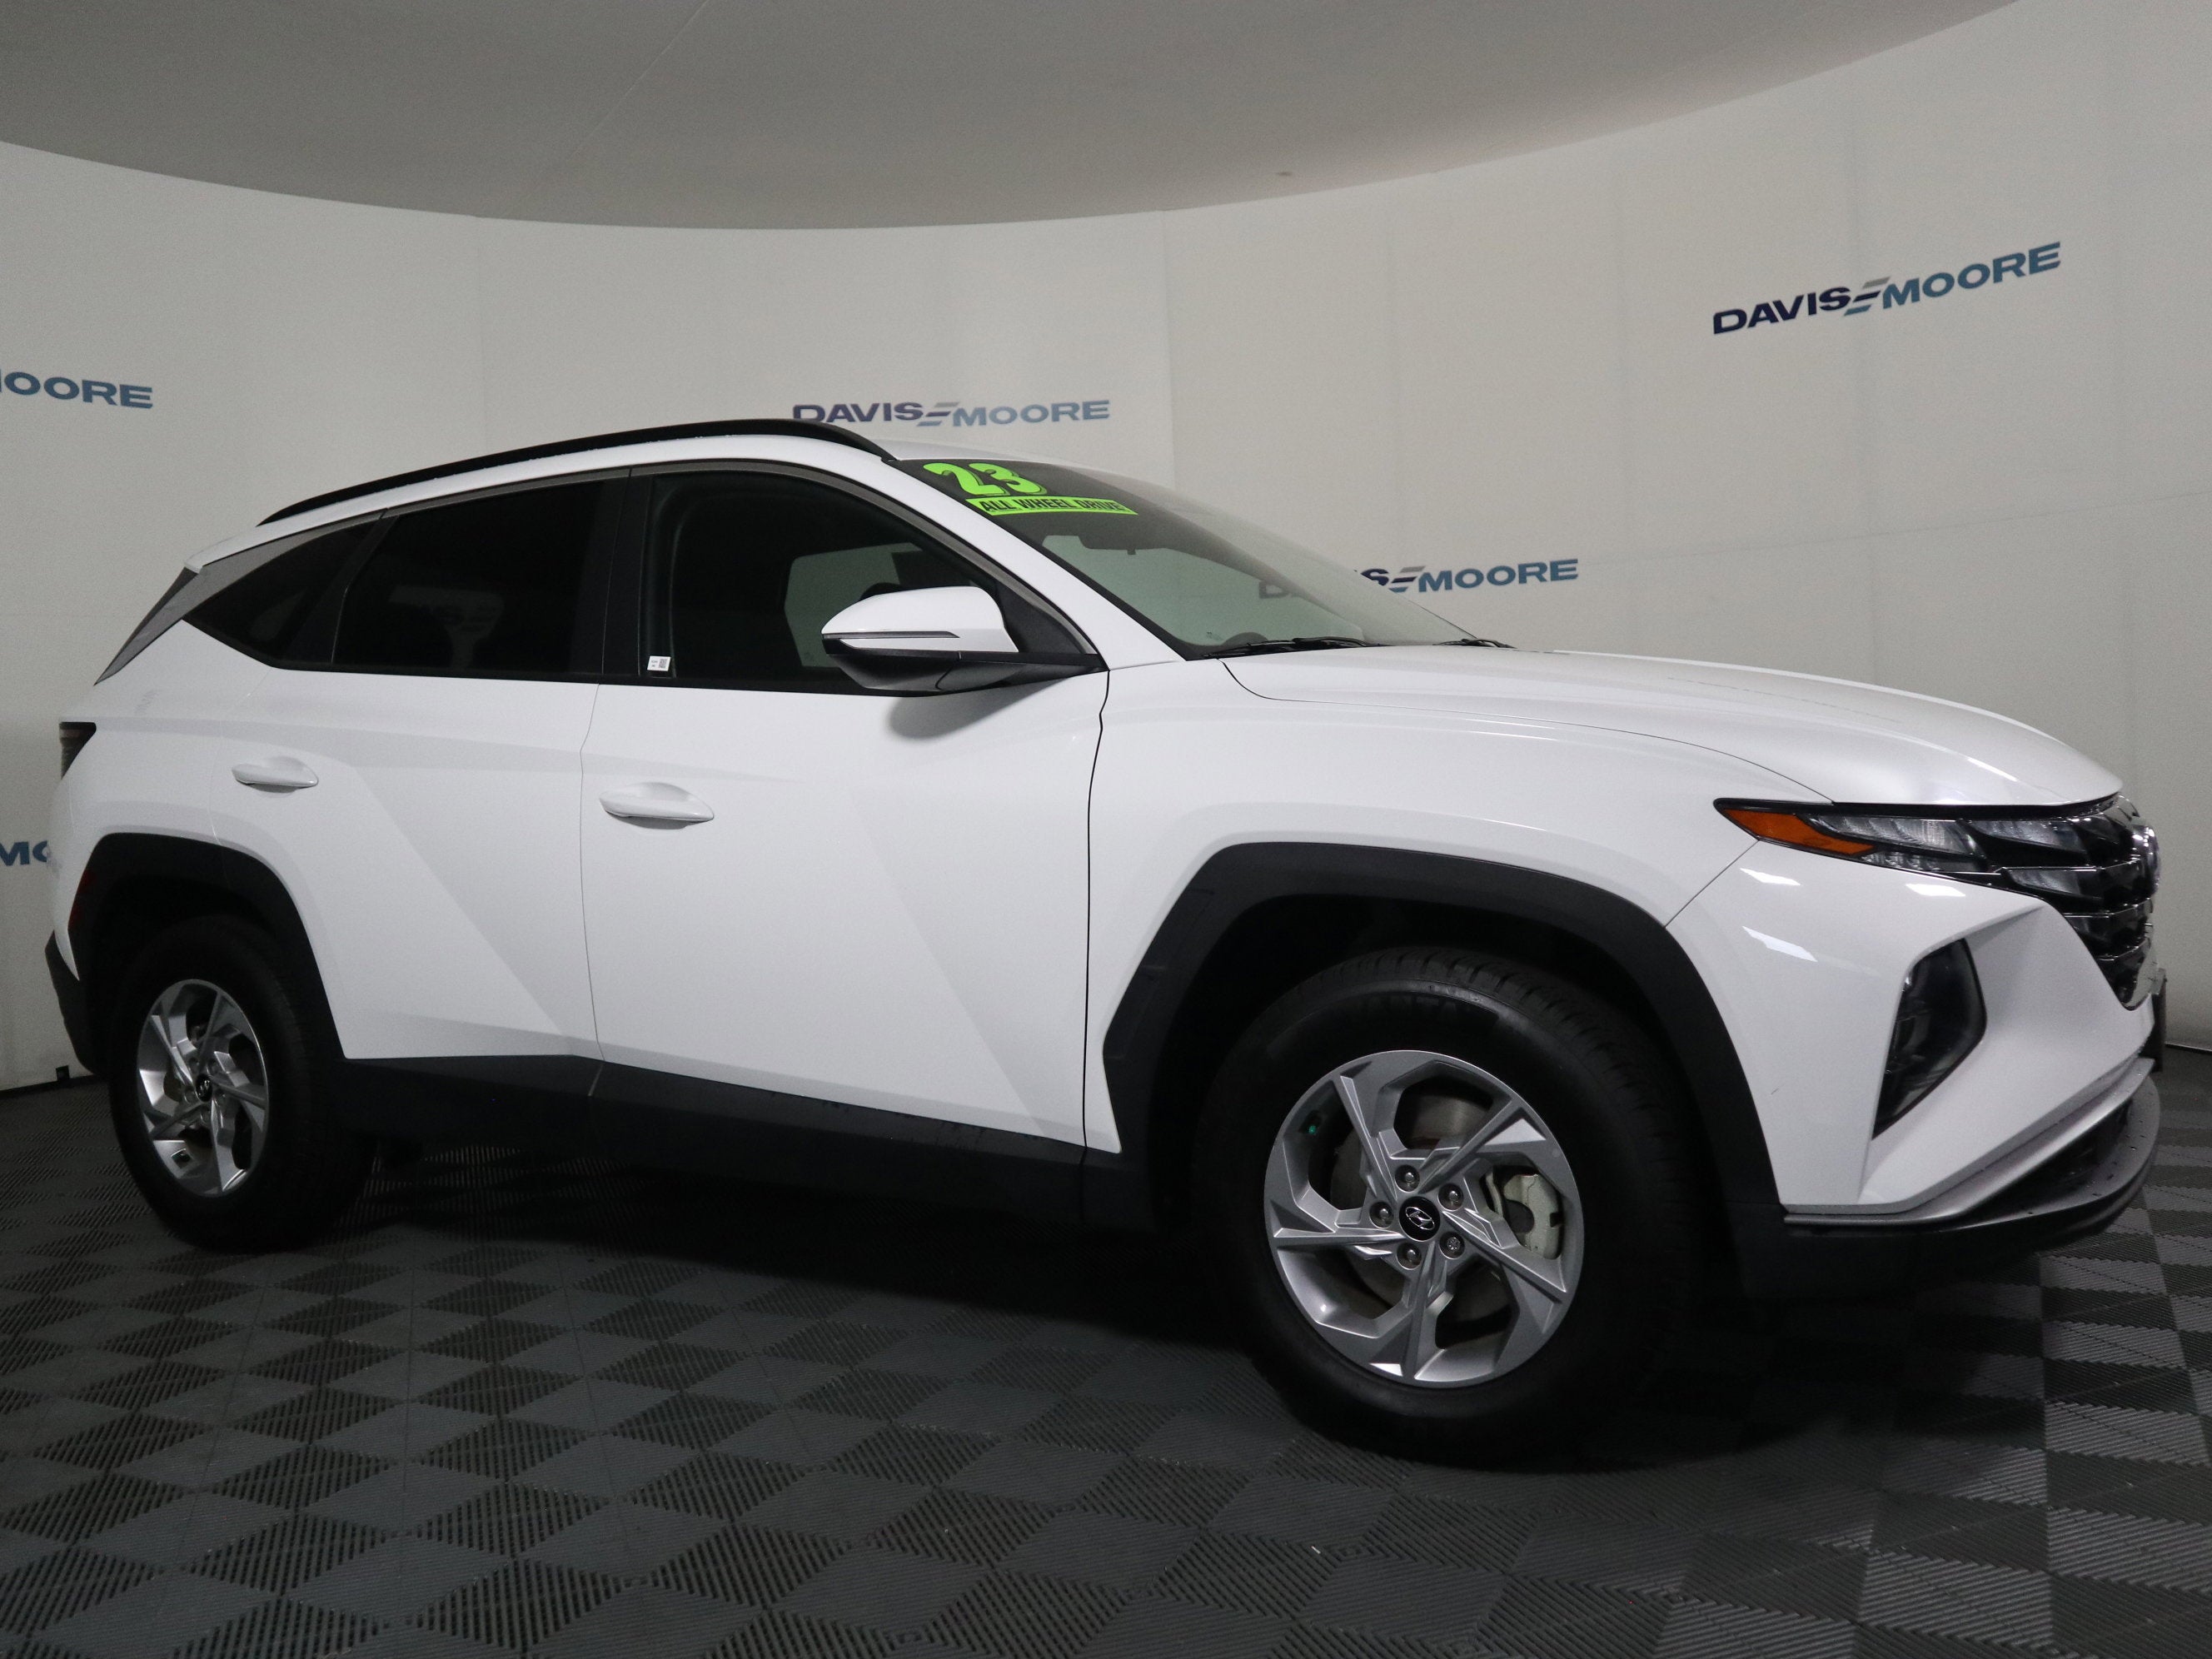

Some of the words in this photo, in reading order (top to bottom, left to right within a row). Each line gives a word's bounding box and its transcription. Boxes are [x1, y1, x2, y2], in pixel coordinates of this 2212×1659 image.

[1713, 286, 1851, 334] DAVIS
[1883, 242, 2061, 309] MOORE
[0, 370, 153, 409] OORE
[793, 401, 924, 423] DAVIS
[952, 400, 1110, 427] MOORE
[923, 462, 1047, 496] 23
[979, 501, 1017, 511] ALL
[1014, 499, 1074, 509] WHEEL
[1074, 500, 1121, 511] DRIVE
[1418, 558, 1579, 592] MOORE
